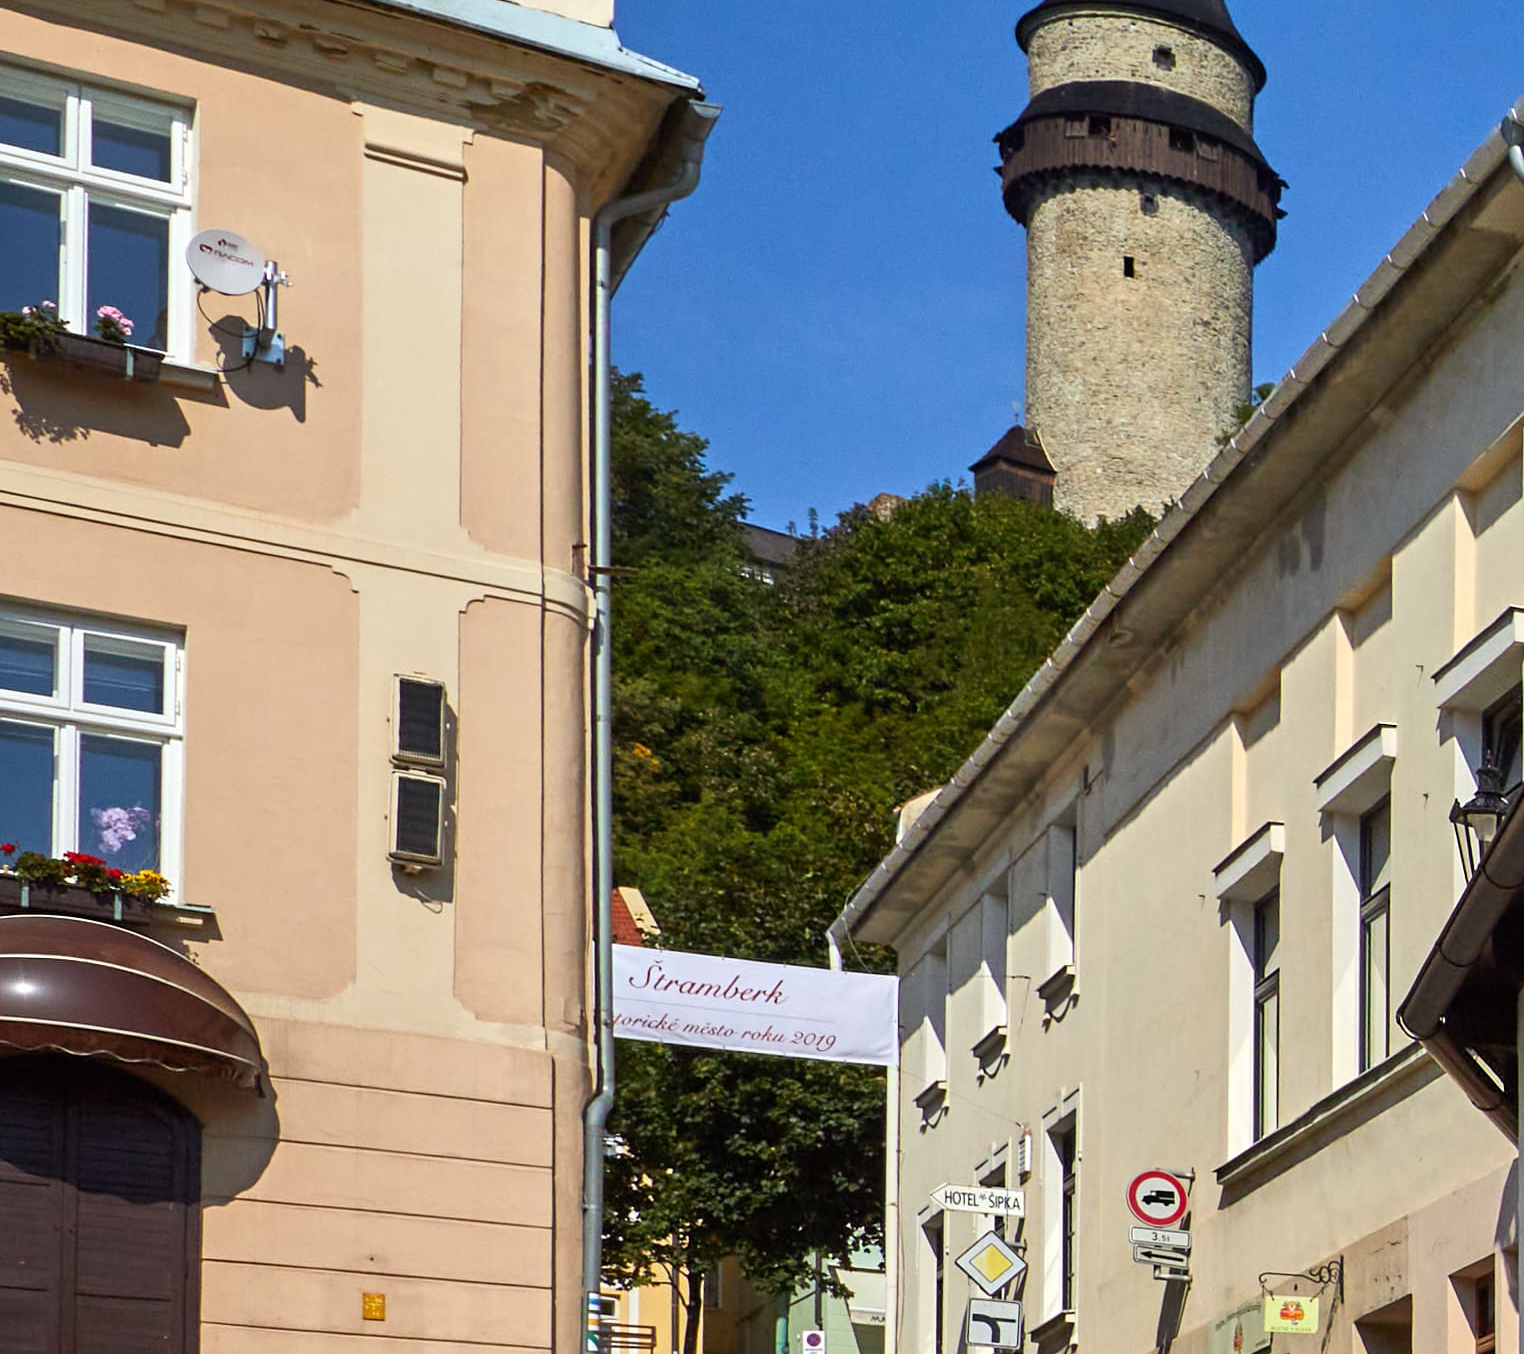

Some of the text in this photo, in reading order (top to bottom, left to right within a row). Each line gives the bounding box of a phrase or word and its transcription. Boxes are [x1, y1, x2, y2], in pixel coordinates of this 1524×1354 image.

[628, 959, 786, 1005] Štramberk
[613, 1012, 837, 1052] torické město roku 2019
[944, 1190, 1020, 1210] HOTEL ŠIPKA
